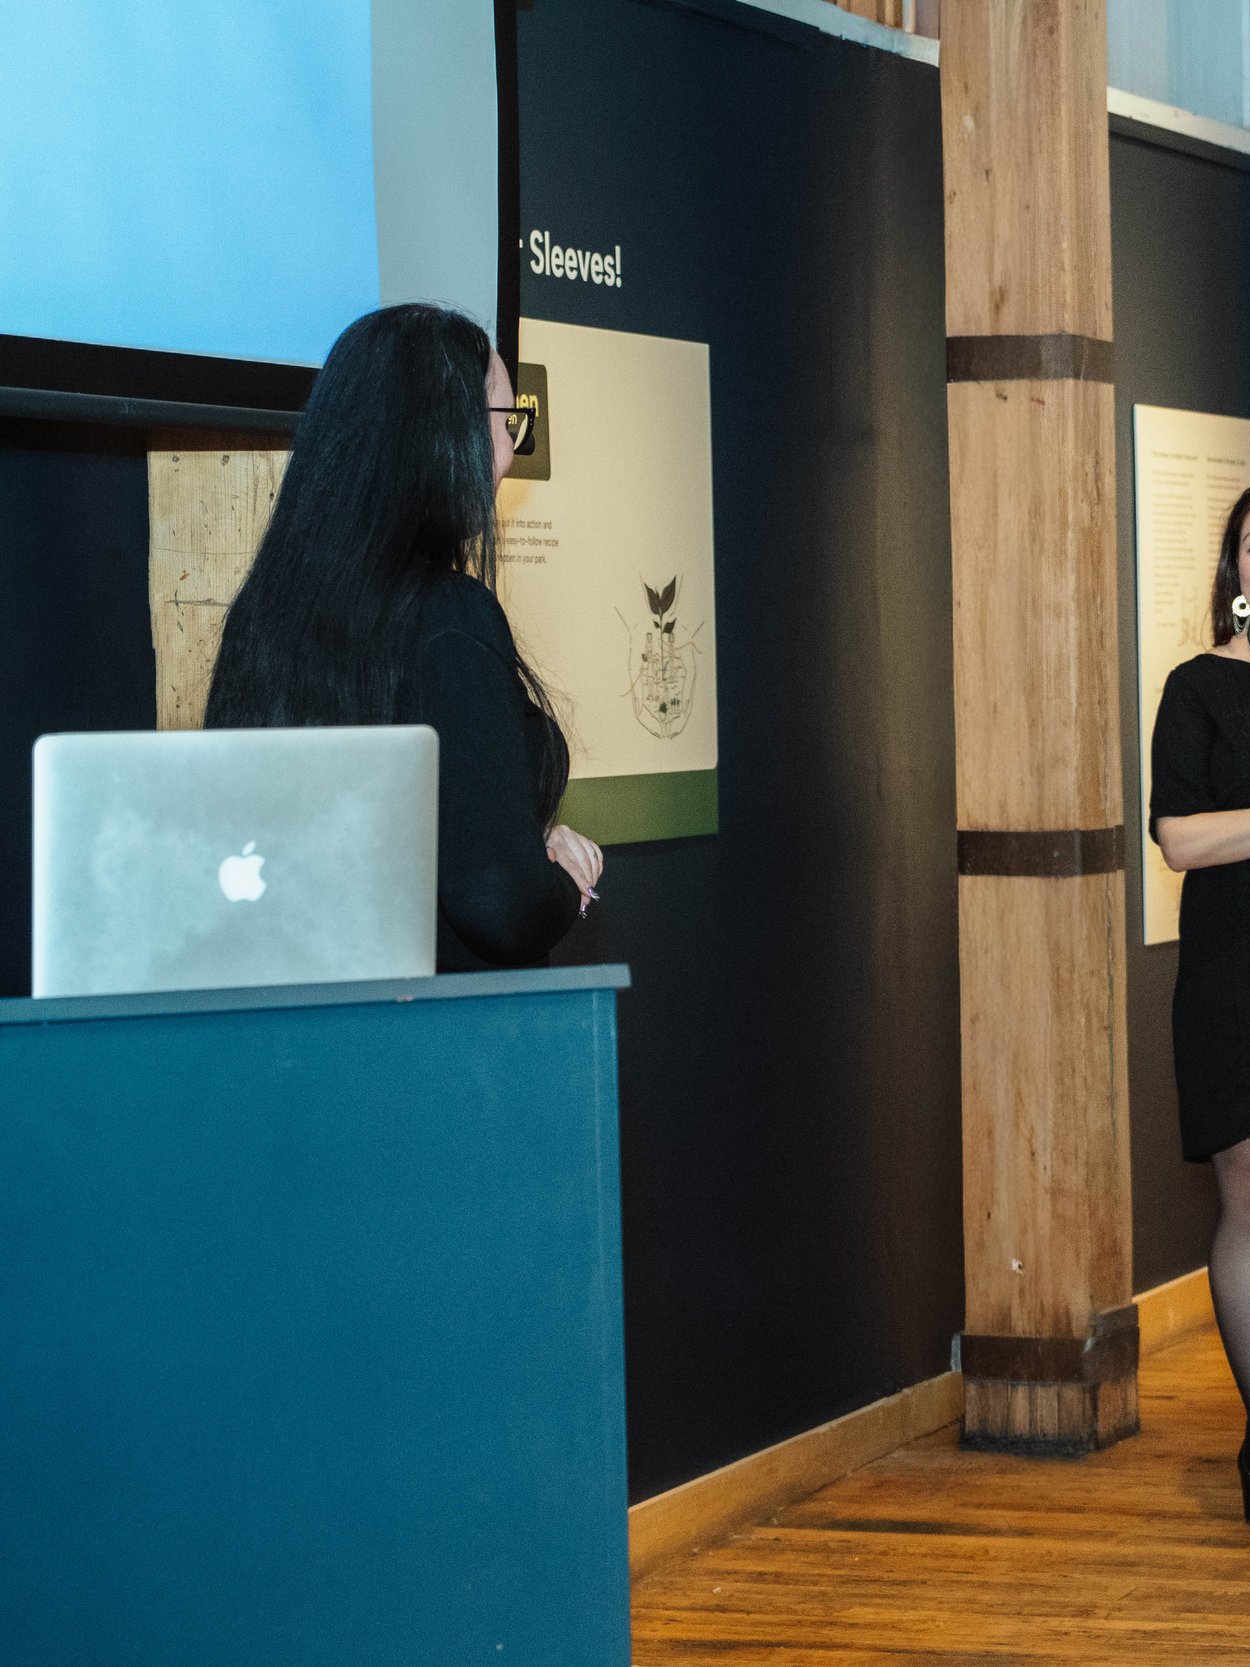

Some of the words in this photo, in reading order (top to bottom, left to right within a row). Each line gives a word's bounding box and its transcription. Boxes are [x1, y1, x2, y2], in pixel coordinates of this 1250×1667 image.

[529, 229, 622, 288] Sleeves!
[516, 520, 526, 528] into
[527, 520, 542, 529] action
[543, 521, 552, 529] and
[506, 536, 542, 547] easy-to-follow
[544, 539, 559, 548] recipe
[523, 554, 534, 565] your
